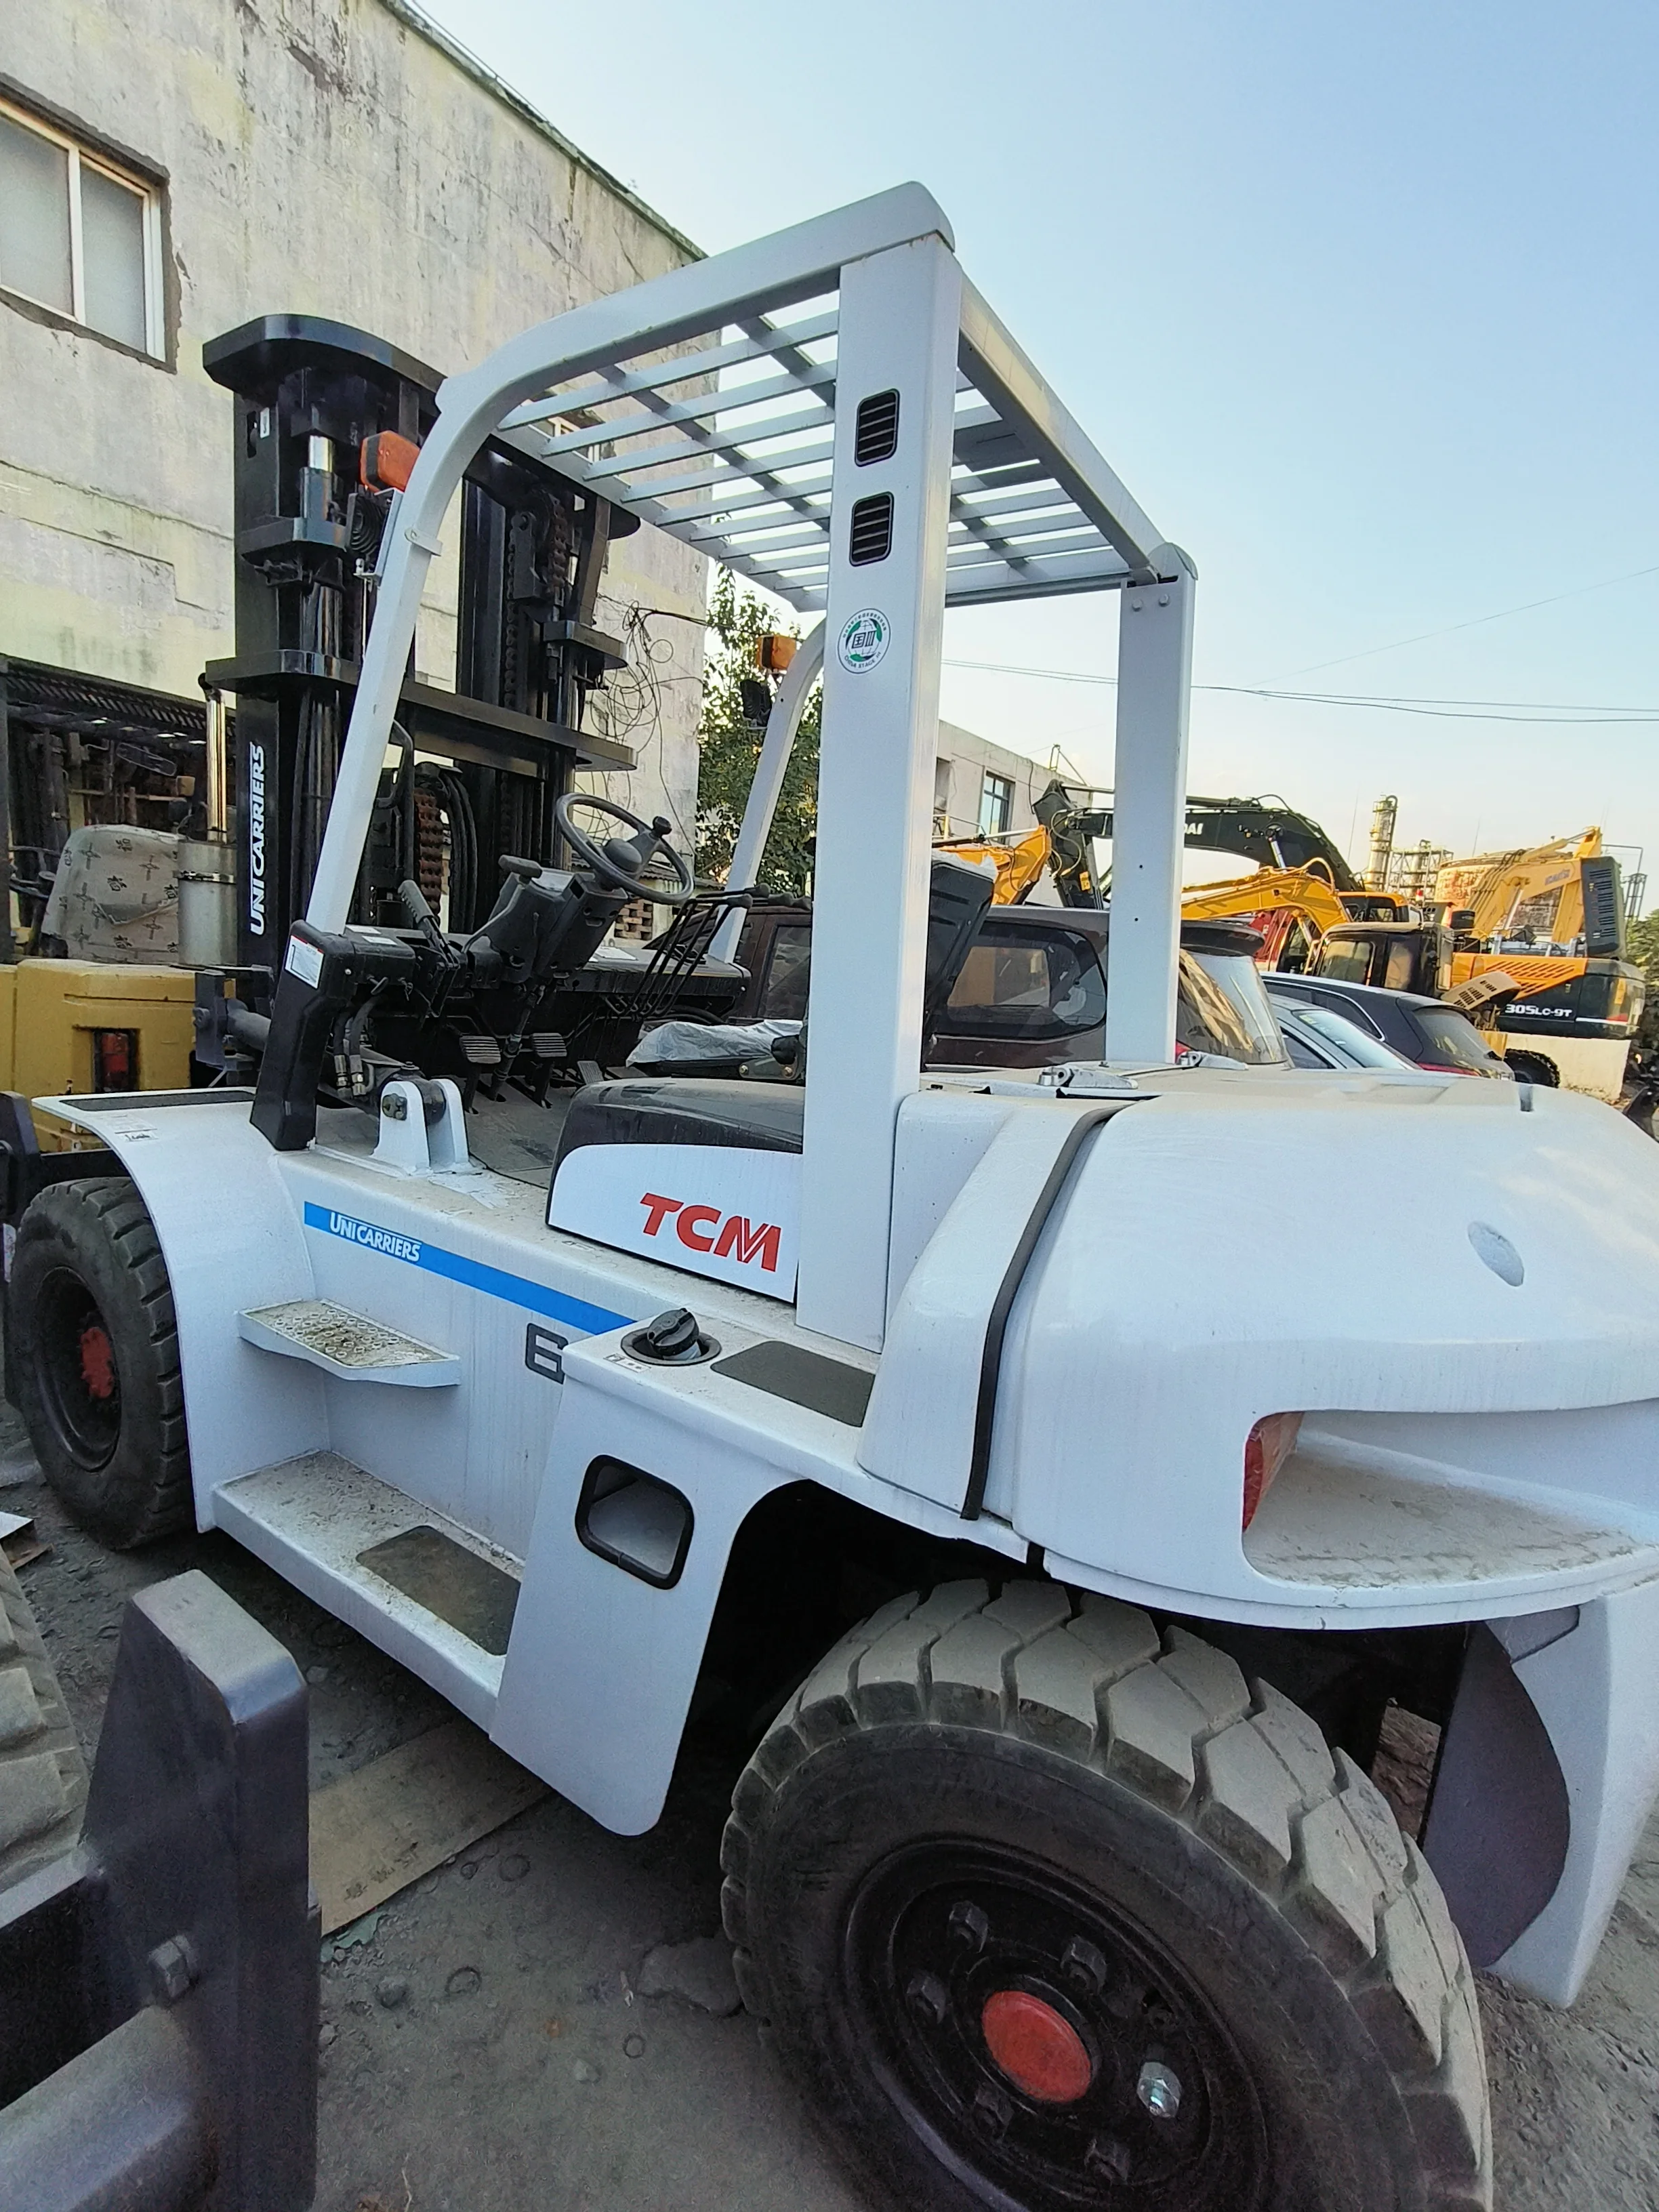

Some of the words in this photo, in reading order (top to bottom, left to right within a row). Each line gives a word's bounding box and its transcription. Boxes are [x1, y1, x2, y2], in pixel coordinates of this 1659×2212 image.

[249, 741, 265, 935] UNICARRIERS
[1504, 1004, 1572, 1017] 305LC-9T
[329, 1212, 422, 1262] UNICARRIERS
[640, 1193, 781, 1272] TCM
